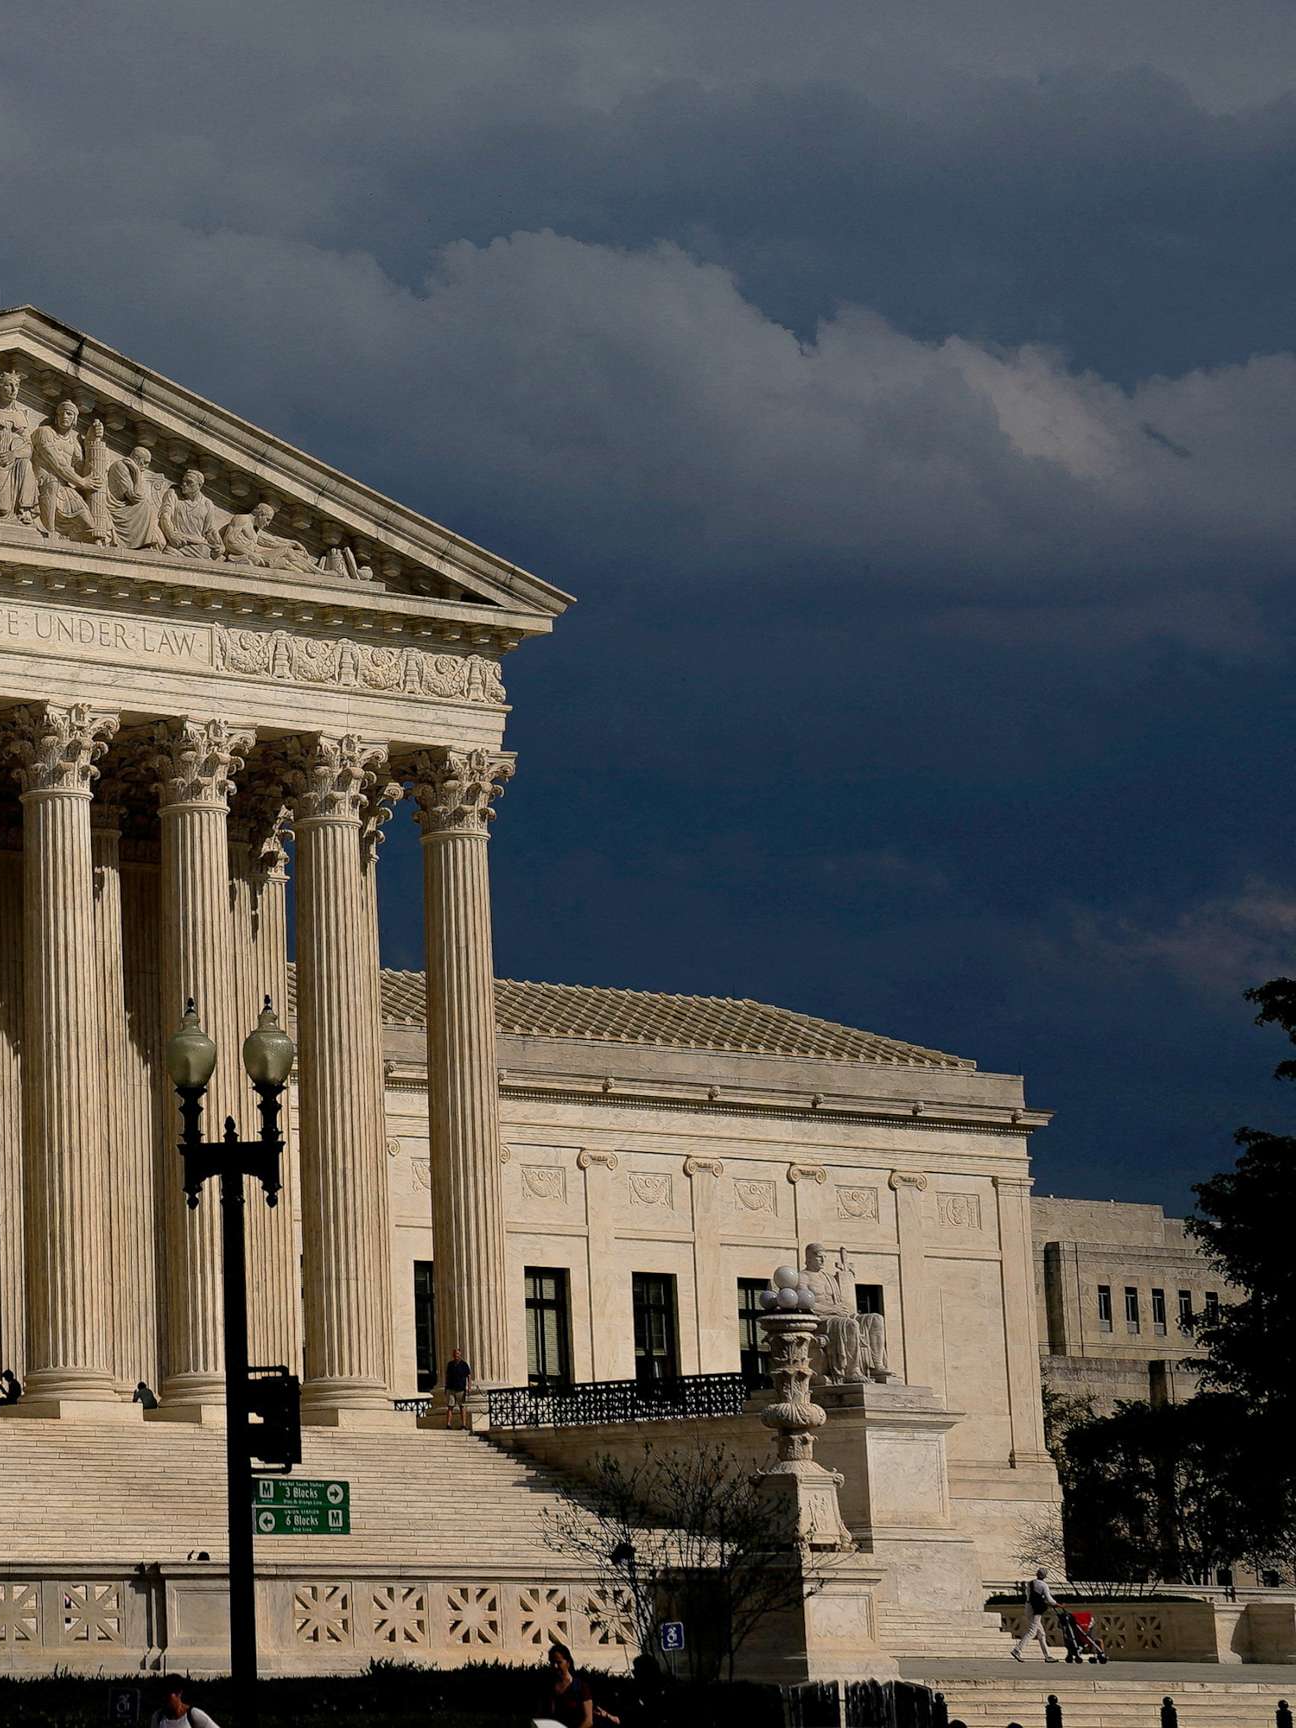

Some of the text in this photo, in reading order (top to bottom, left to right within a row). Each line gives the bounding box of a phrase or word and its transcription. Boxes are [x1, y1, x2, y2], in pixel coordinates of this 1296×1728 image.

[34, 612, 132, 650] UNDER
[142, 626, 197, 657] LAW
[285, 1487, 318, 1499] 3 Blocks
[285, 1514, 319, 1526] 6 Blocks
